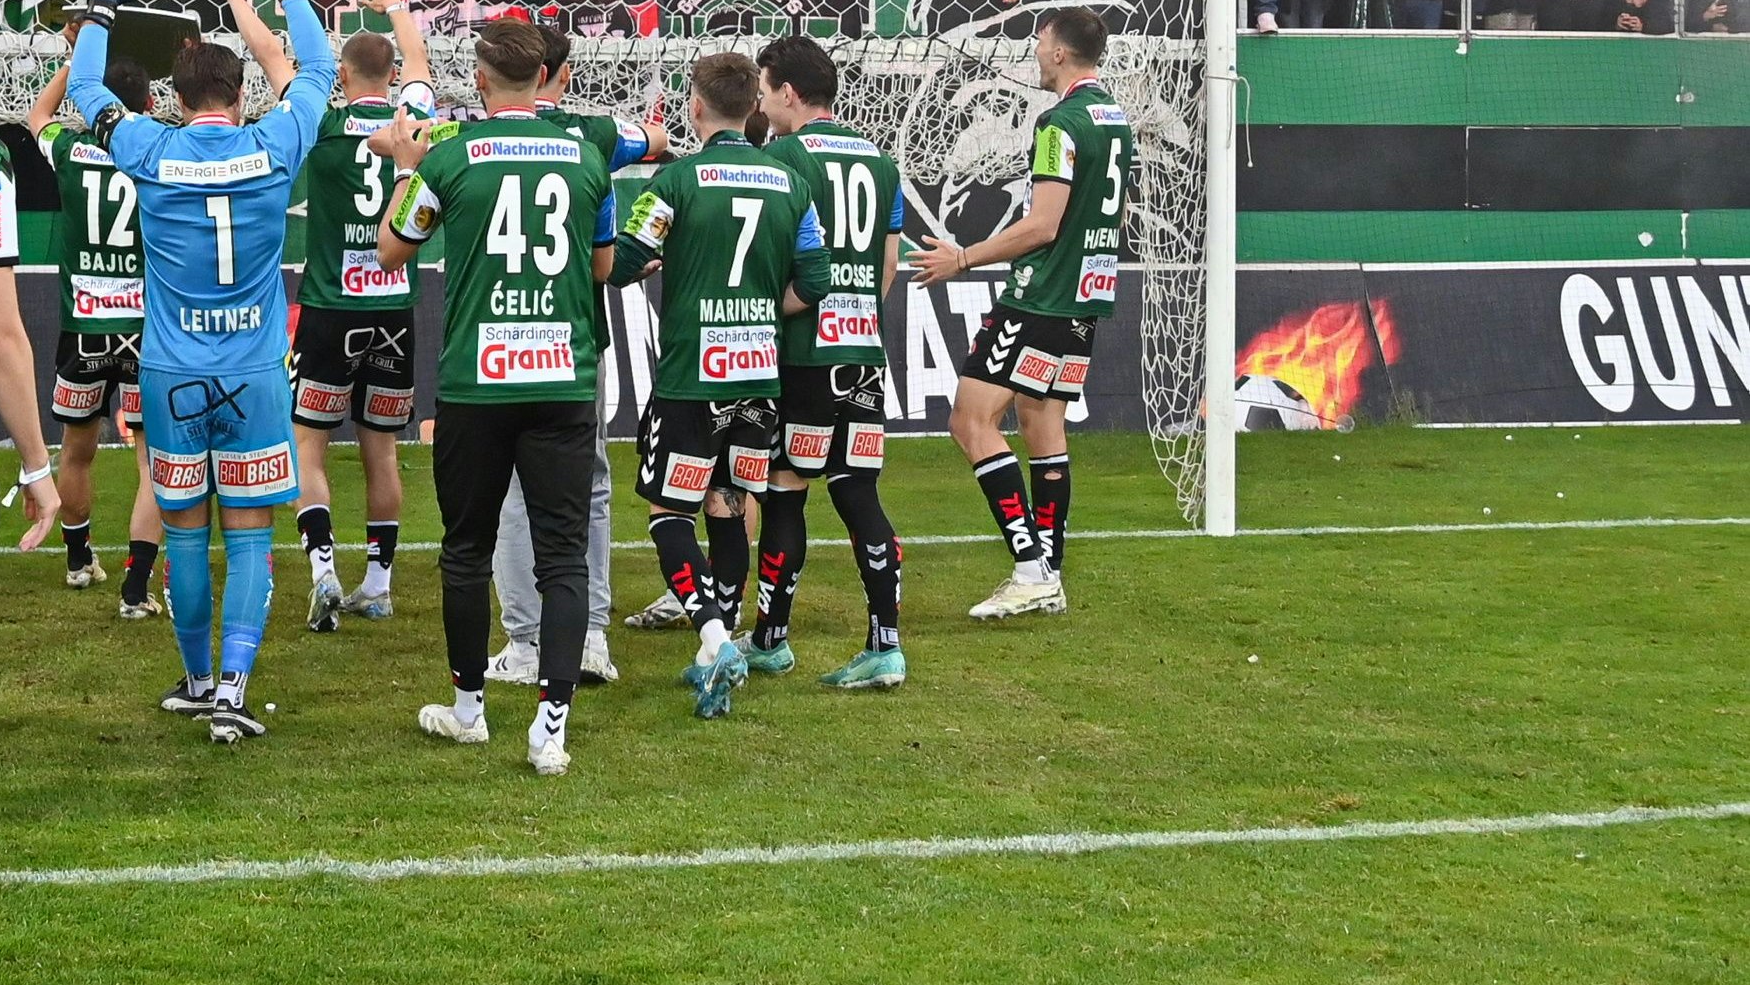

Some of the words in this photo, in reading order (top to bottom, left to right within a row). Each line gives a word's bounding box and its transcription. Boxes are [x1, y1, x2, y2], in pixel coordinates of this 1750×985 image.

[471, 139, 578, 158] OÖNachrichten
[165, 165, 227, 177] ENERGIE
[230, 159, 263, 174] RIED
[353, 138, 384, 217] 3
[700, 166, 787, 187] OÖNachrichten
[1101, 137, 1121, 215] 5
[82, 170, 137, 247] 12
[825, 161, 877, 253] 10
[344, 223, 378, 244] WOHL
[486, 172, 570, 276] 43
[206, 194, 235, 285] 1
[727, 196, 764, 287] 7
[79, 251, 137, 273] BAJIC
[830, 263, 875, 288] ROSSE
[75, 290, 143, 315] Granit
[700, 298, 776, 322] MARINSEK
[180, 304, 261, 332] LEITNER
[345, 326, 407, 357] OX
[486, 327, 569, 342] Schärdinger
[480, 343, 572, 380] Granit
[703, 344, 777, 378] Granit
[220, 455, 286, 484] BAUBAST
